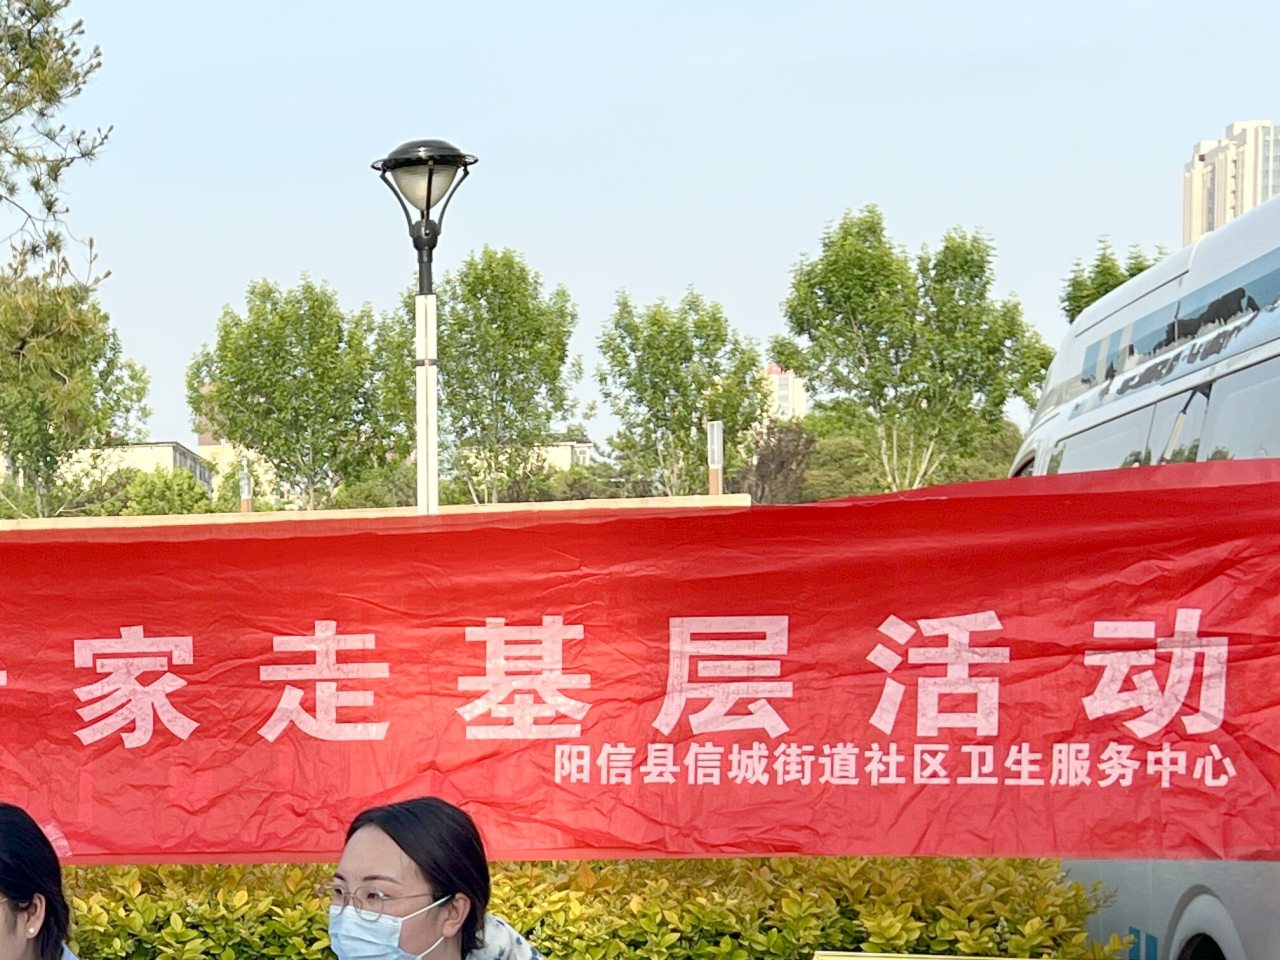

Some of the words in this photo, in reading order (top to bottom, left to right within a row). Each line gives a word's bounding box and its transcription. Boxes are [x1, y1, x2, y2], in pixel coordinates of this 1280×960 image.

[552, 741, 1238, 790] 阳信县信城街道社区卫生服务中心
